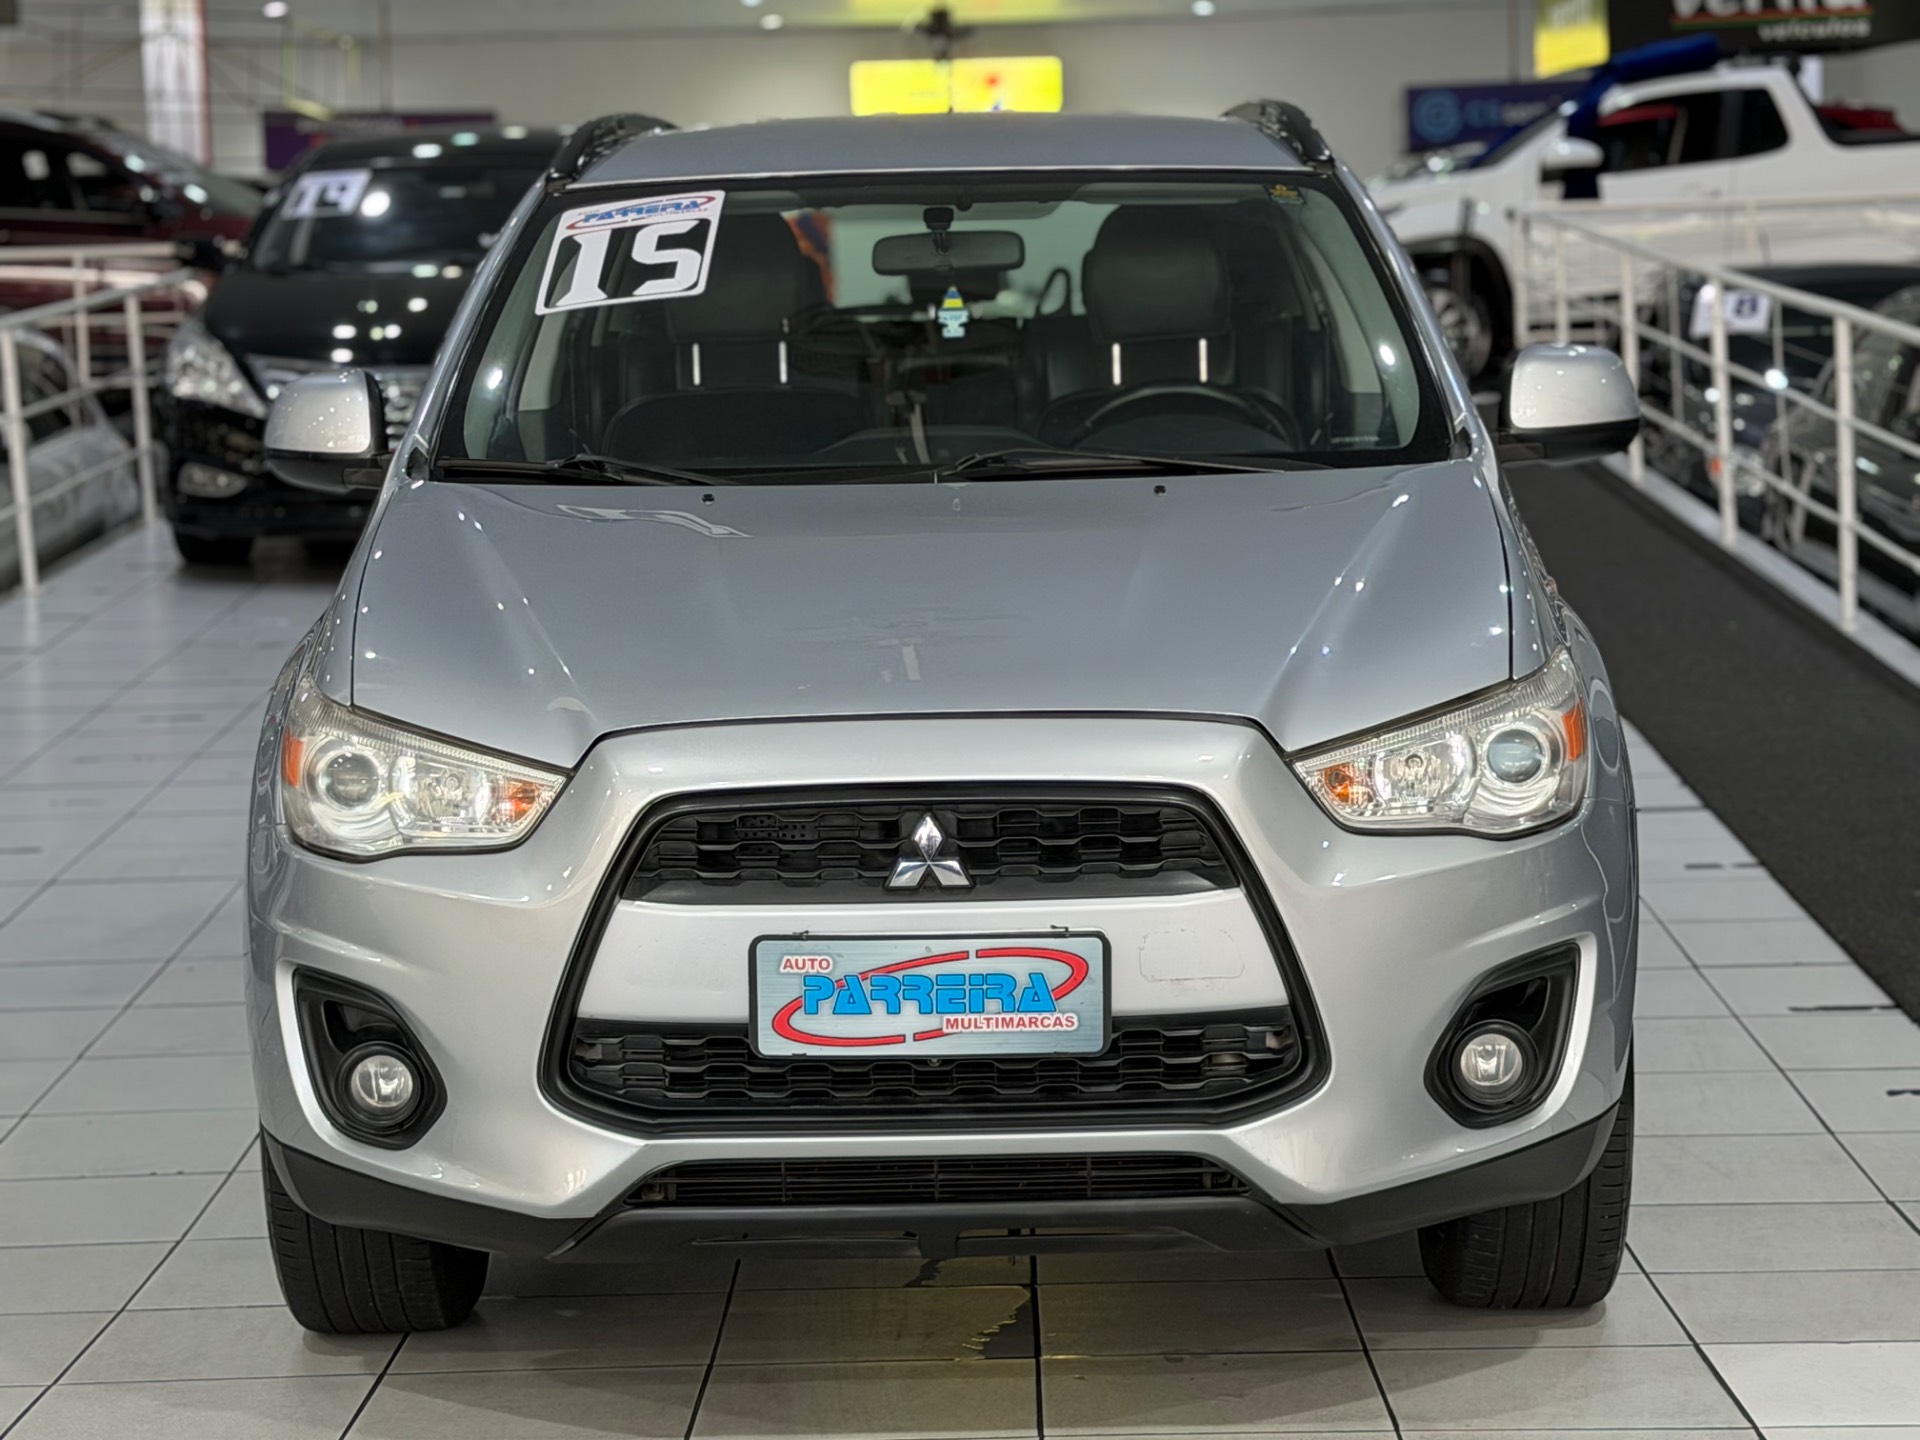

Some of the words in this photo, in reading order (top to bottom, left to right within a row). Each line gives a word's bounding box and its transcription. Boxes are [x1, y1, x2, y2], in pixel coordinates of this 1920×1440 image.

[555, 219, 702, 307] 15
[782, 957, 832, 972] AUTO
[803, 973, 1057, 1015] PARREIRA
[945, 1015, 1076, 1031] MULTIMARCAS
